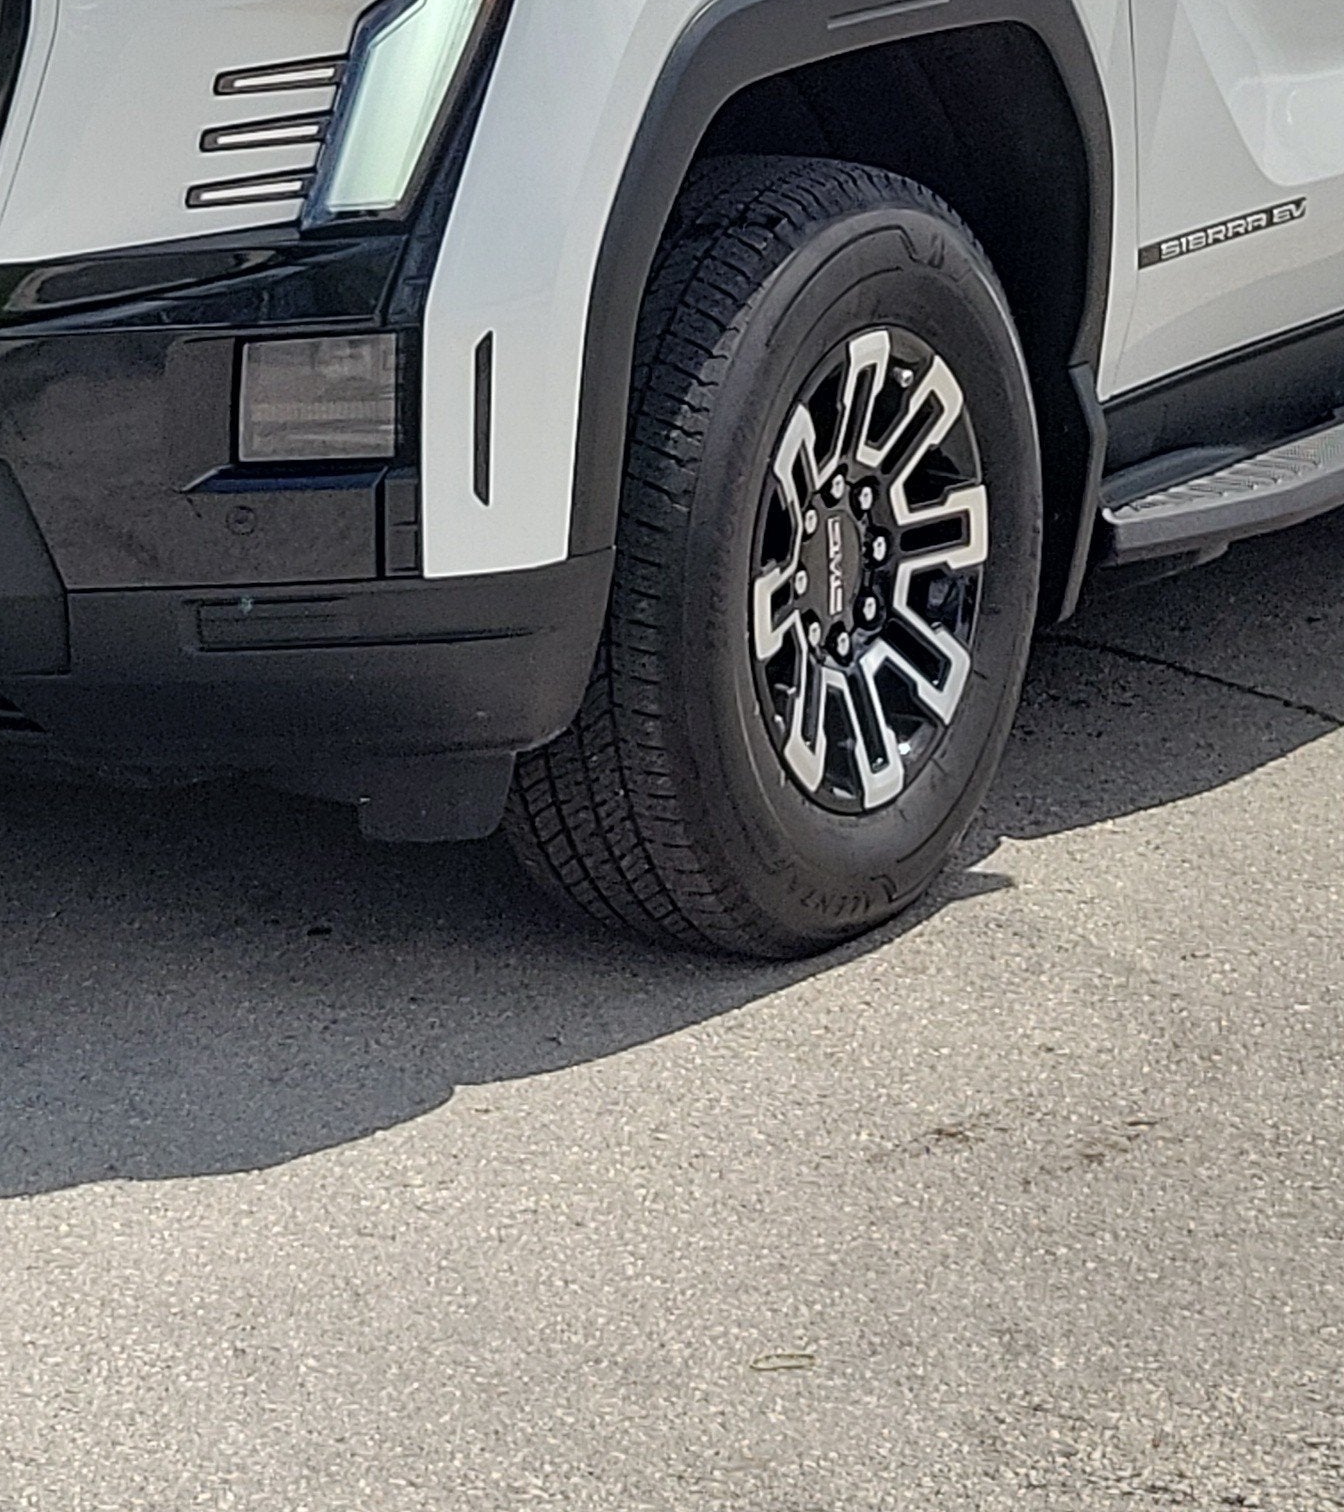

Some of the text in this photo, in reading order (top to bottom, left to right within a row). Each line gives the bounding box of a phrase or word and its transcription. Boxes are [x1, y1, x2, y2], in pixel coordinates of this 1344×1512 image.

[1160, 199, 1307, 260] SIERRA EV
[827, 516, 843, 616] GMC
